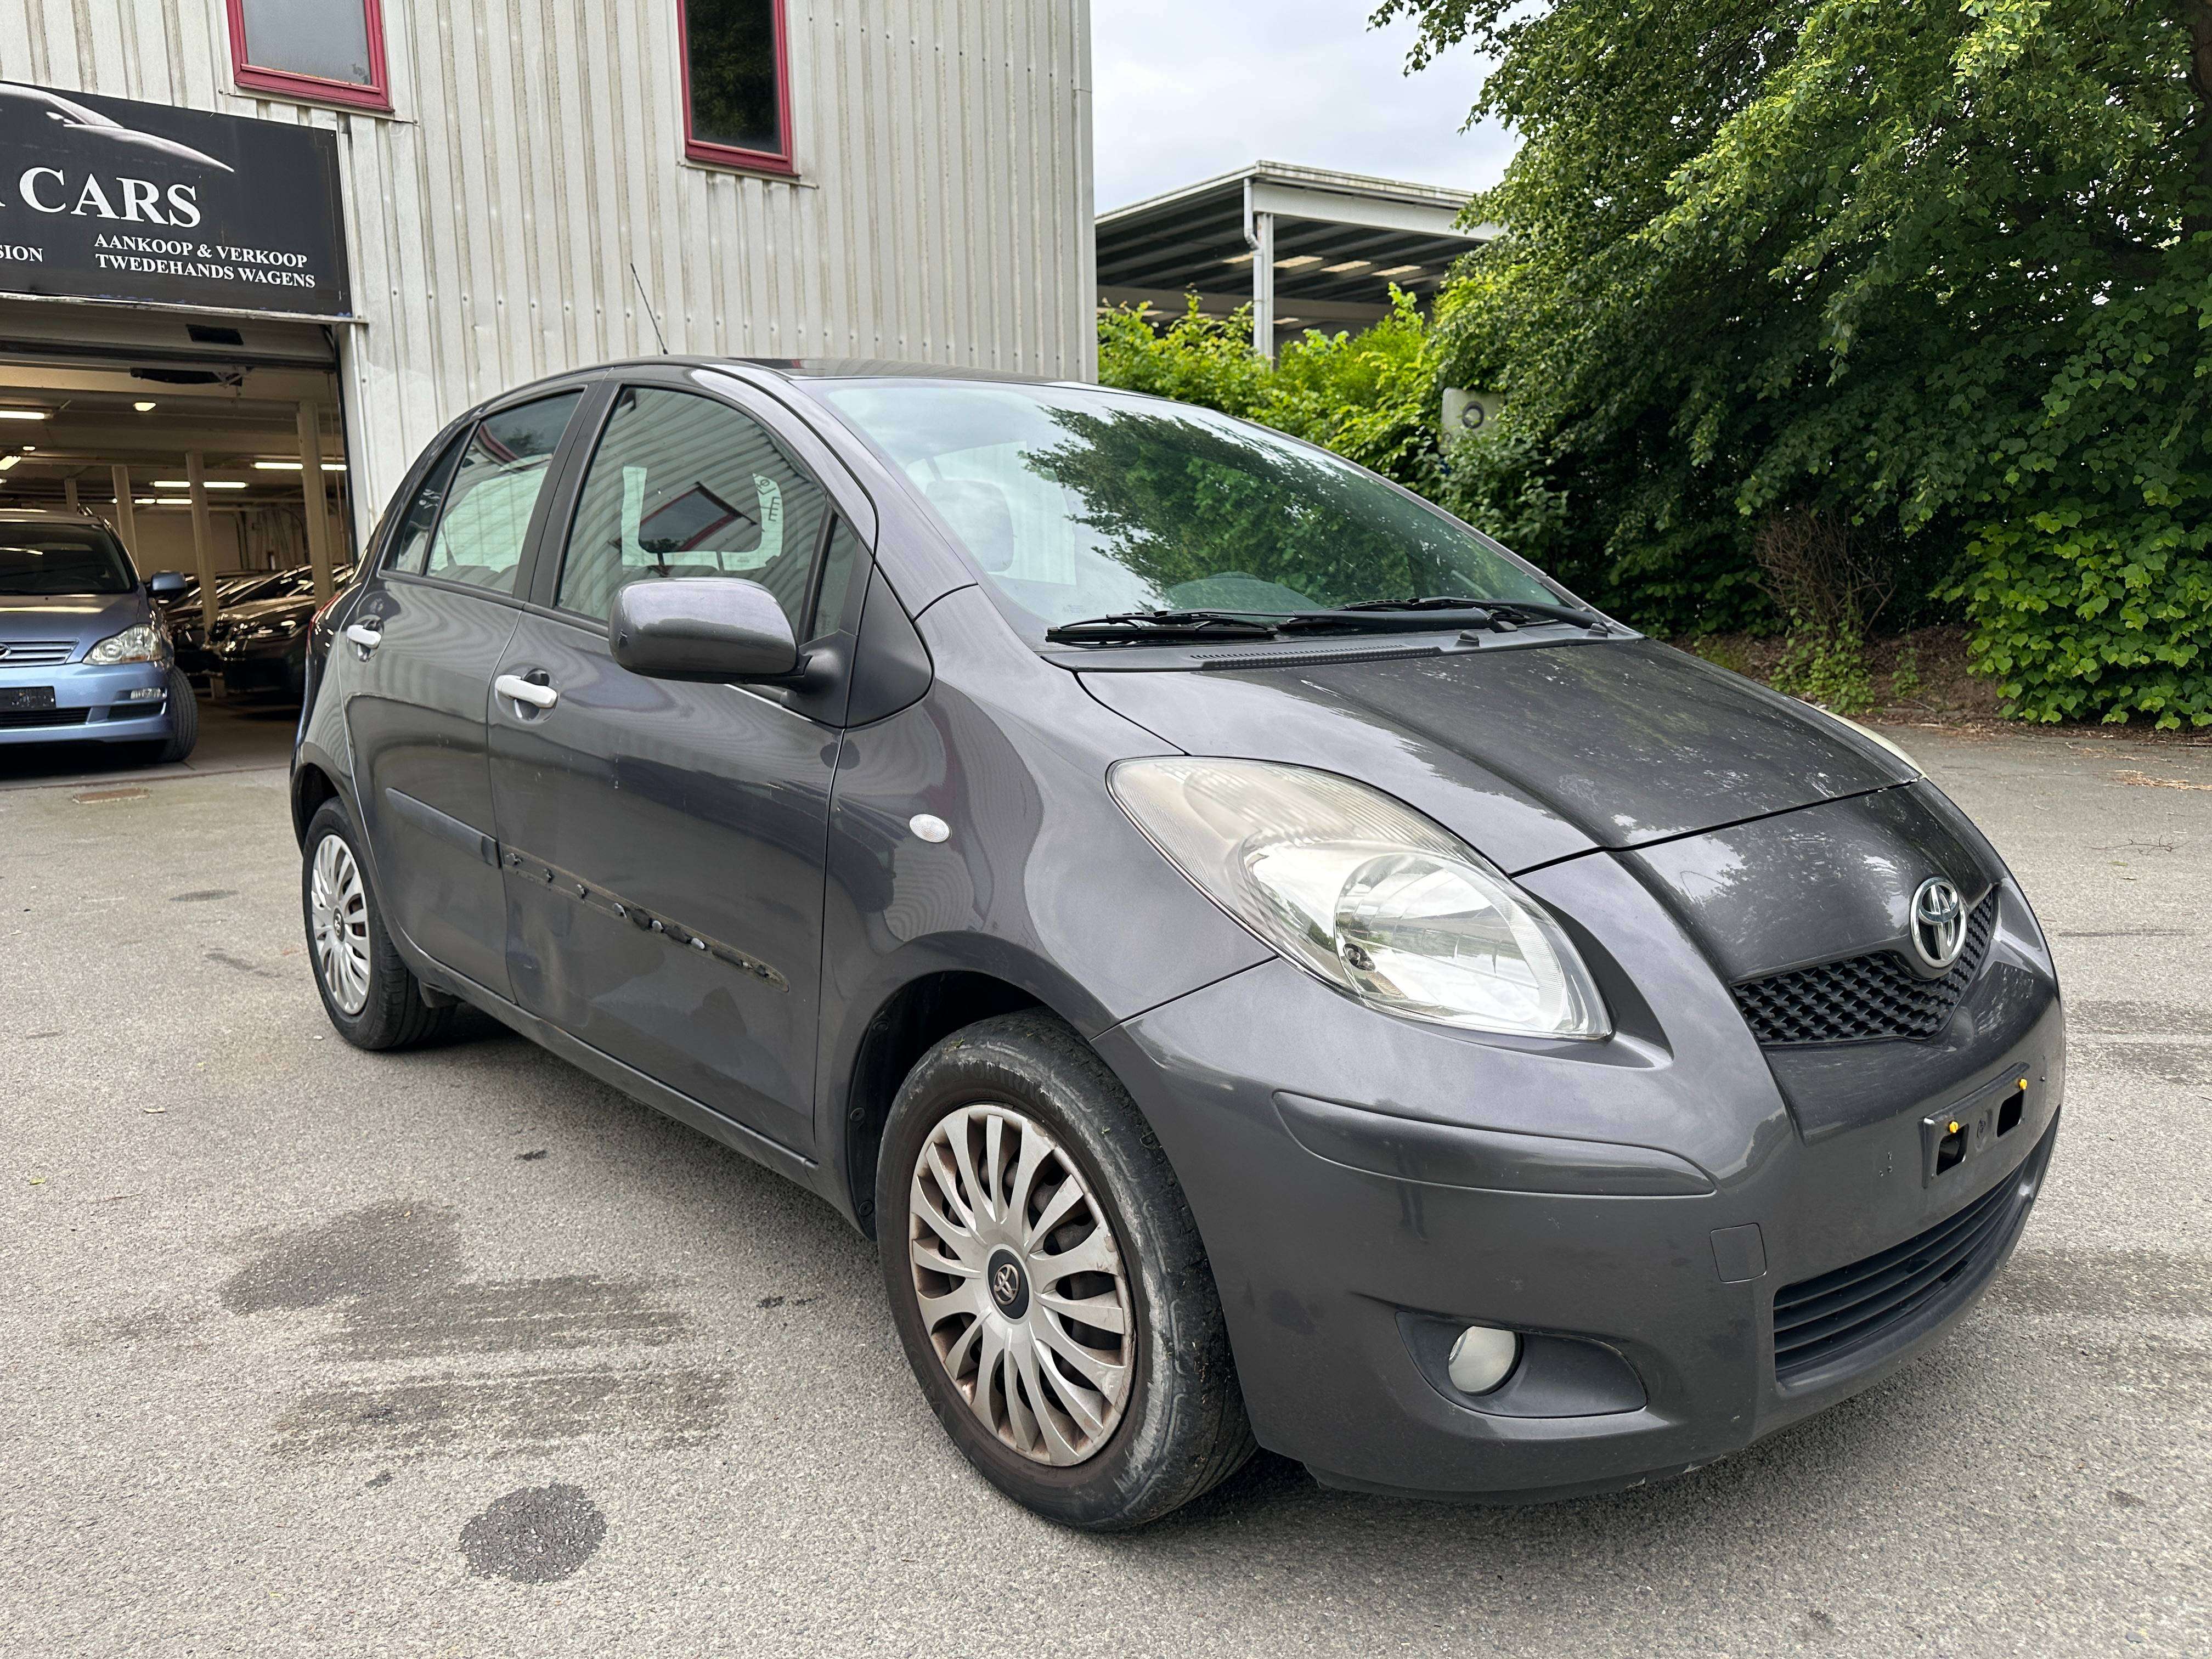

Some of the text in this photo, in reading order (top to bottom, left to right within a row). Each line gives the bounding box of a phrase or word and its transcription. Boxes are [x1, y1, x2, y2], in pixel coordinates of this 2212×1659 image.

[20, 167, 201, 228] CARS
[94, 233, 307, 268] AANKOOP & VERKOOP
[95, 253, 315, 289] TWEDEHANDS WAGENS
